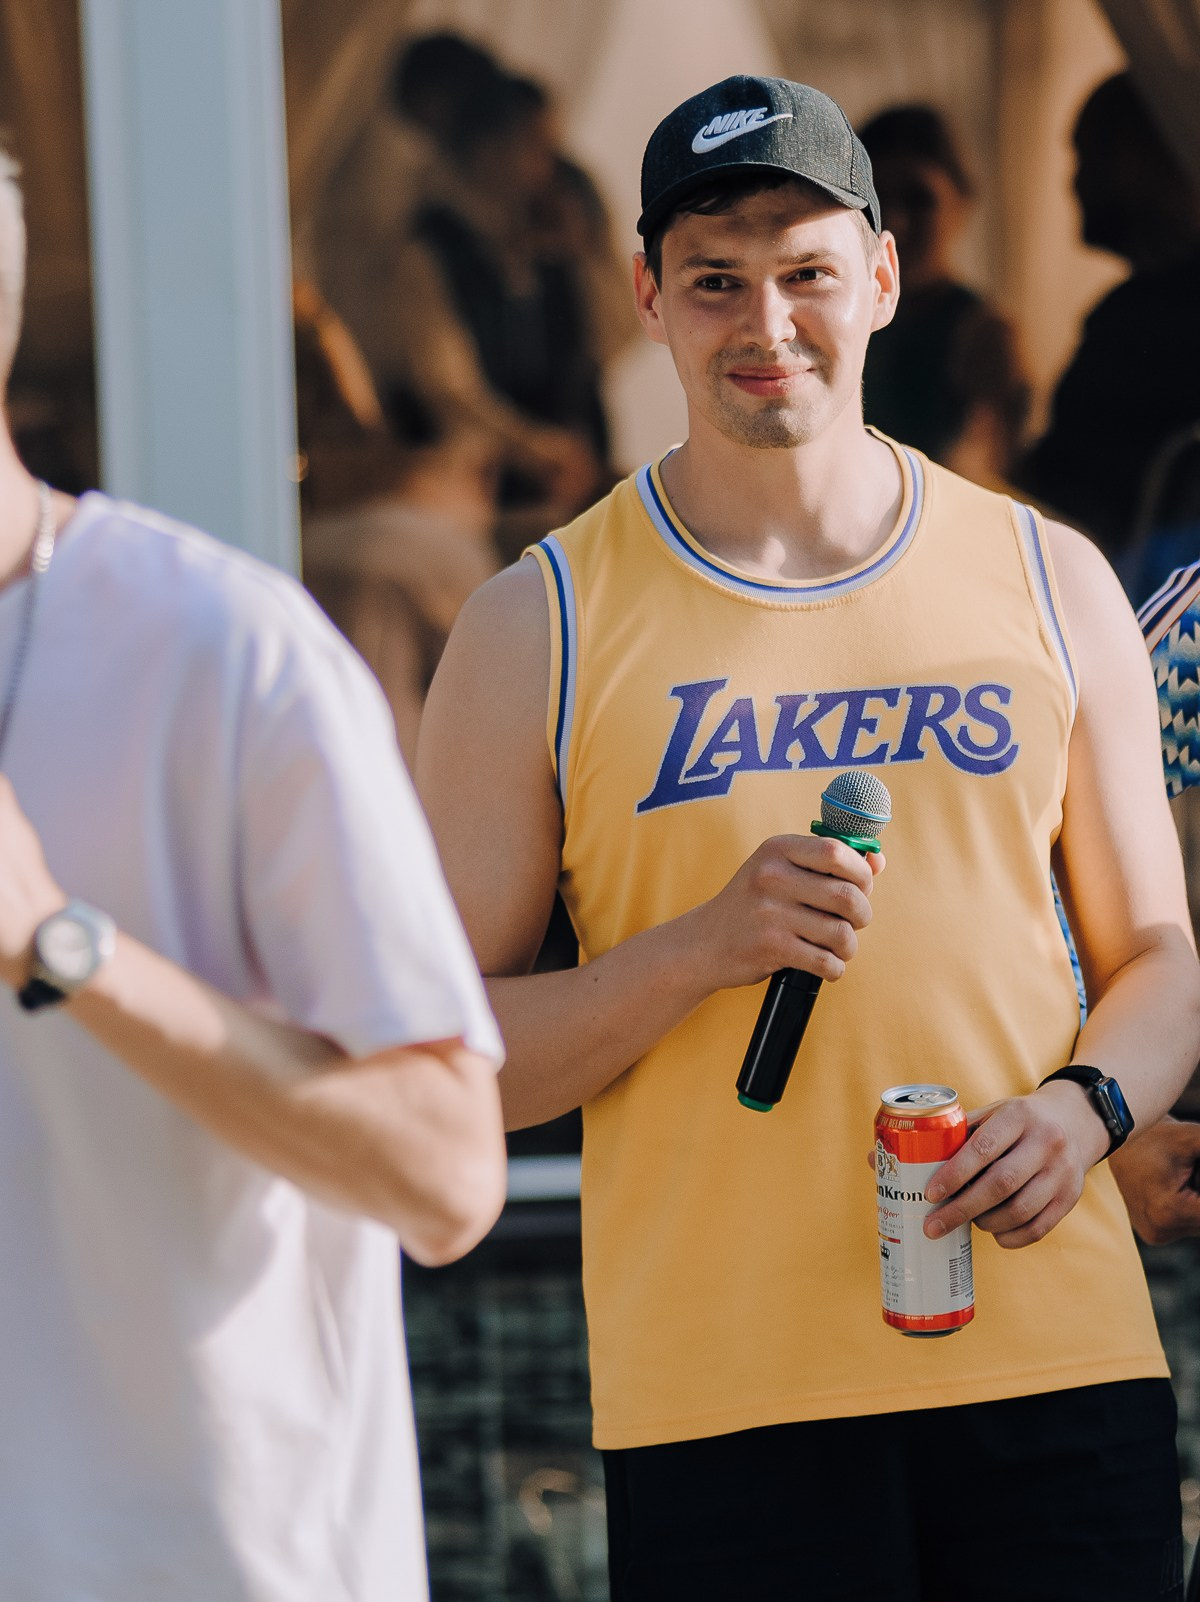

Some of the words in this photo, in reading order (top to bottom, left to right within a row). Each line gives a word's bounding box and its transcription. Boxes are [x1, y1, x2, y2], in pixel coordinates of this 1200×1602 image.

[704, 107, 768, 136] NIKE
[634, 676, 1020, 818] LAKERS
[876, 1184, 928, 1202] nKron
